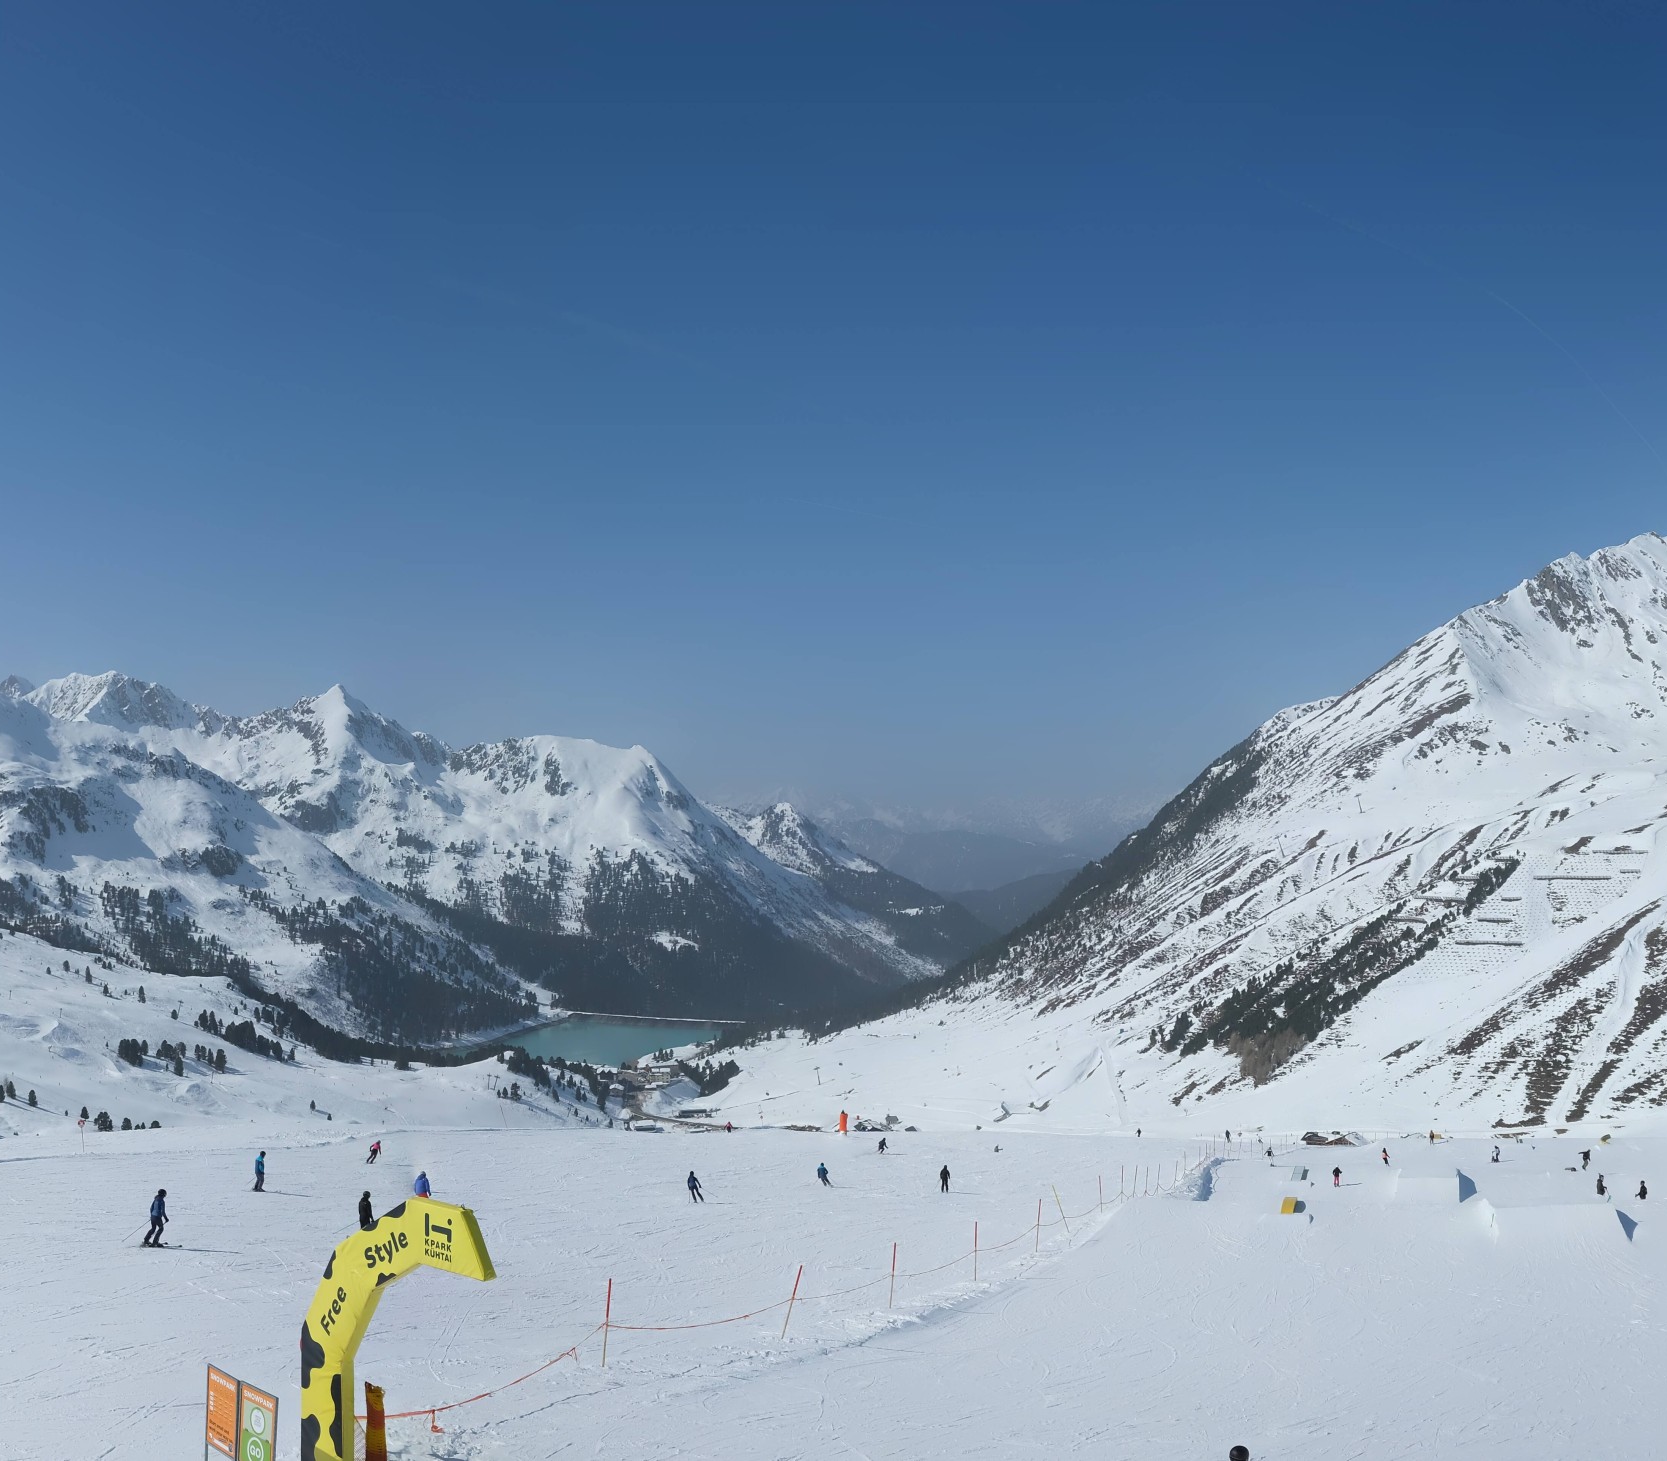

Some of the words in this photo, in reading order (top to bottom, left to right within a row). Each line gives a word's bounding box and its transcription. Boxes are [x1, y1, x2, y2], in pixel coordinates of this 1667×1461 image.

[424, 1238, 452, 1253] KPARK
[424, 1247, 452, 1263] KÜHTAI
[320, 1286, 347, 1336] Free
[364, 1232, 409, 1268] Style
[210, 1372, 236, 1392] SNOWPARK
[243, 1389, 274, 1409] SNOWPARK
[249, 1444, 261, 1459] GO
